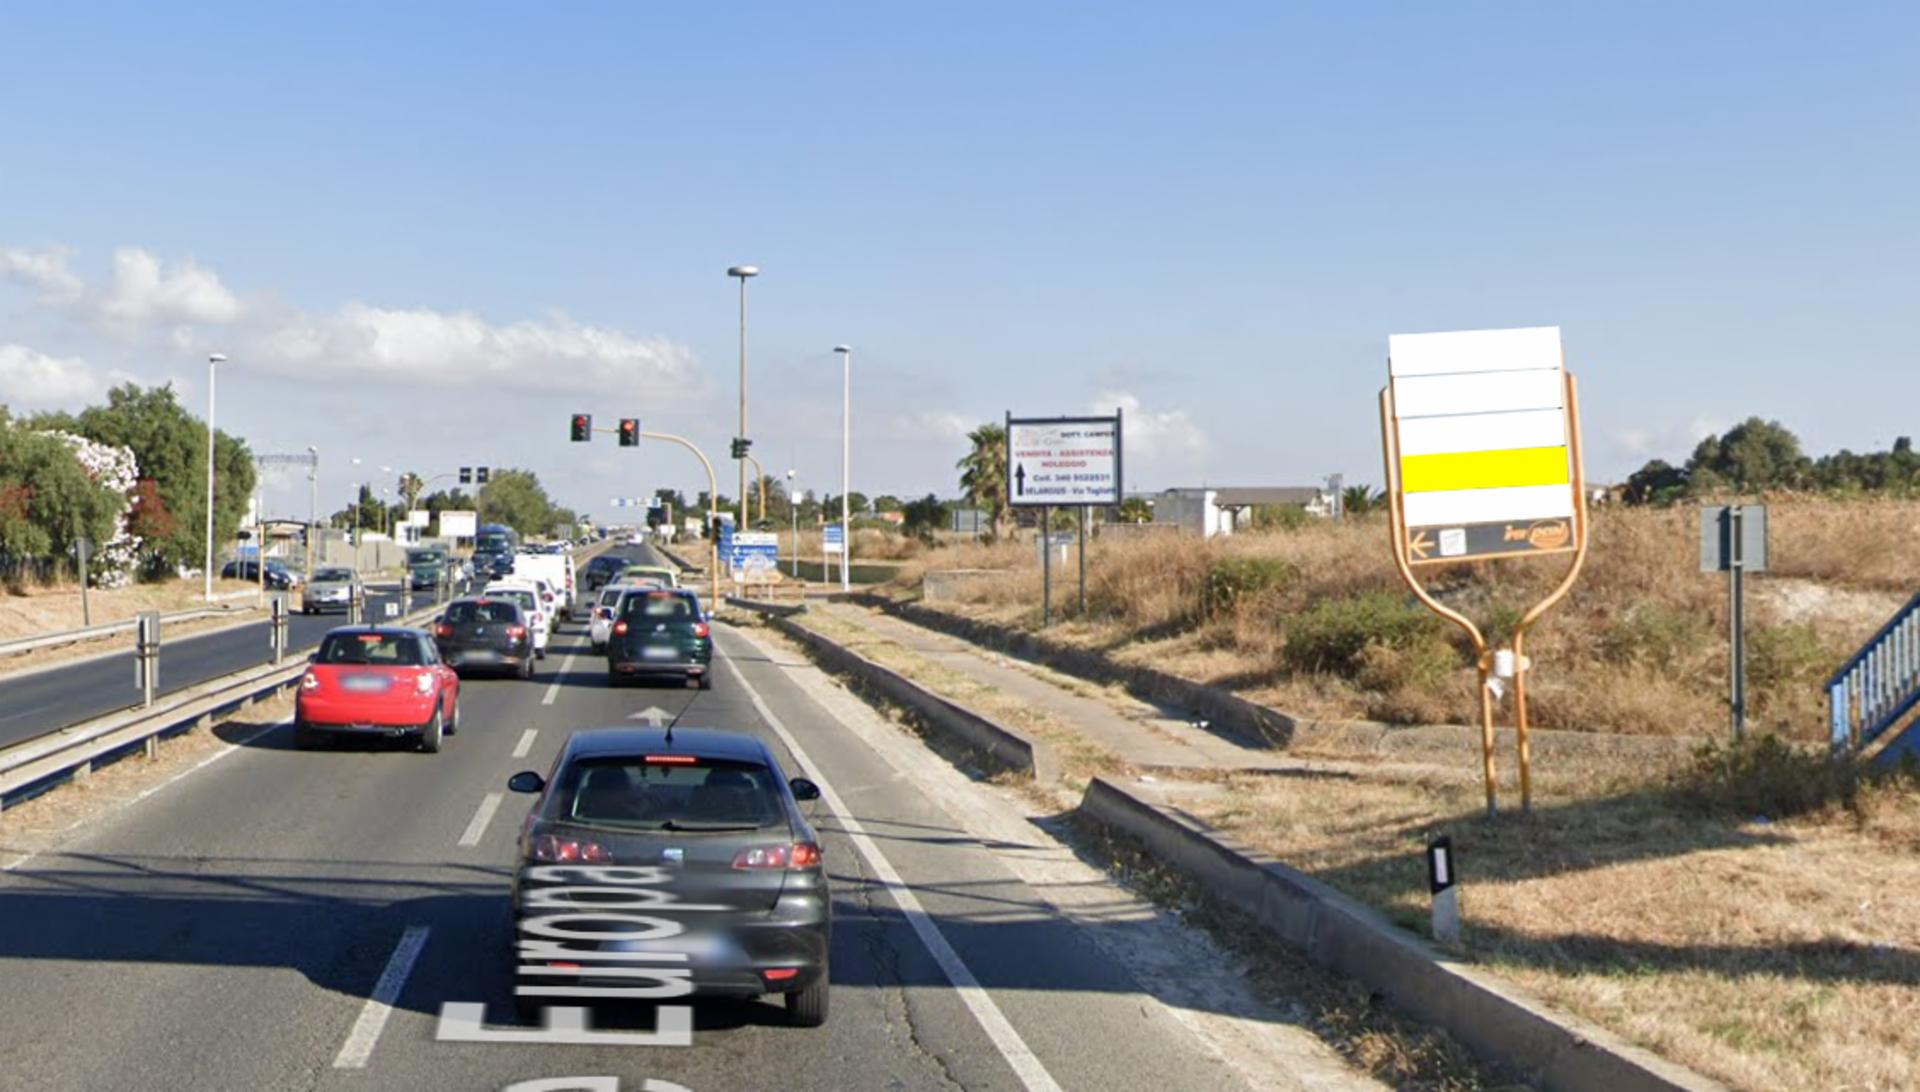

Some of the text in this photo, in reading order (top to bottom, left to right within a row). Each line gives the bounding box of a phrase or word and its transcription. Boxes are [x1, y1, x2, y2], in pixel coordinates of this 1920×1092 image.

[1015, 448, 1115, 458] VENDITA ASSISTENZA
[1041, 460, 1088, 468] NOLEGGIO
[1072, 486, 1085, 495] Via
